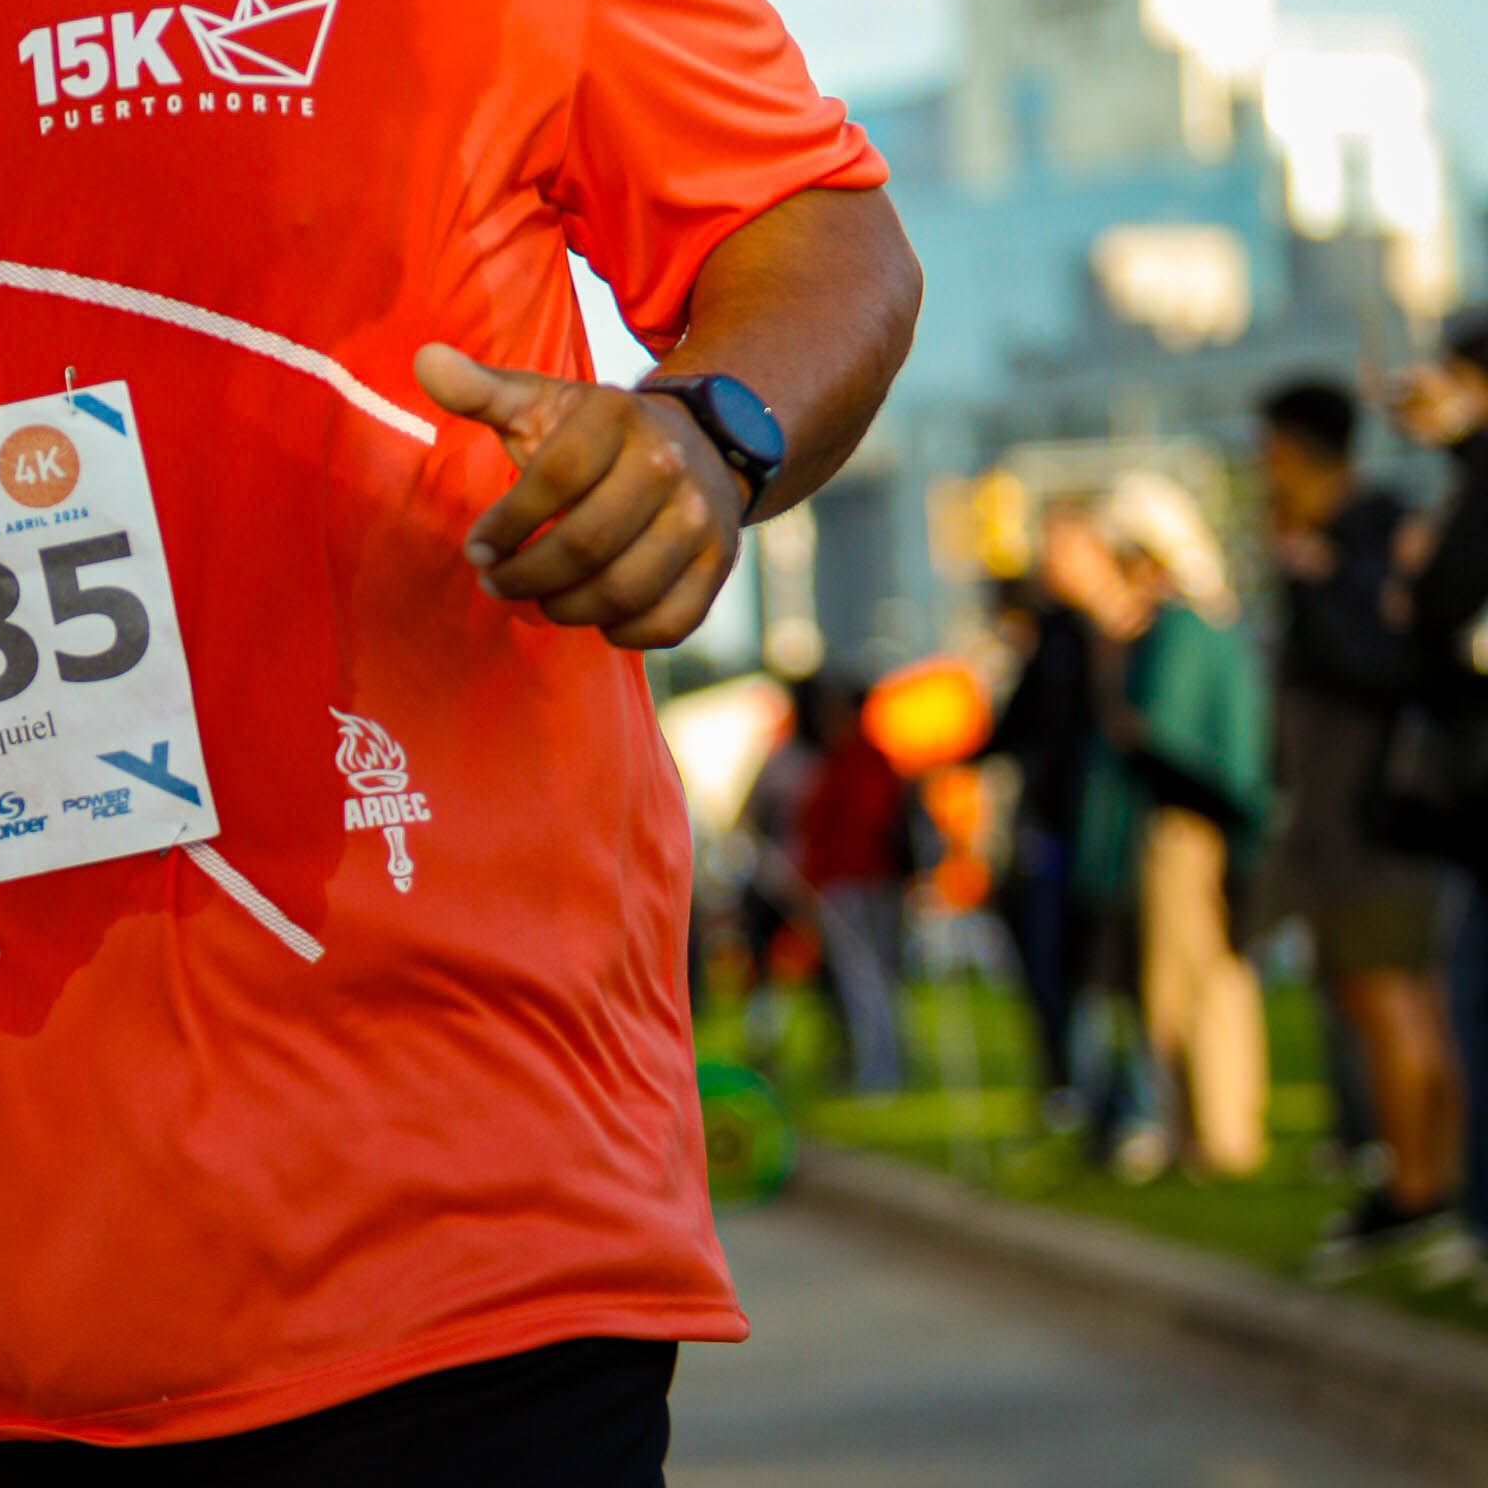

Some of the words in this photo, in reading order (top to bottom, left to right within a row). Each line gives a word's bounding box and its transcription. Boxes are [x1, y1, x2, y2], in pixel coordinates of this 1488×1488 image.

[18, 7, 182, 106] 15K
[39, 95, 182, 135] PUERTO
[199, 91, 315, 117] NORTE
[14, 445, 66, 485] 4K
[5, 515, 48, 533] ABRIL
[63, 787, 131, 813] POWER
[344, 791, 433, 832] ARDEC
